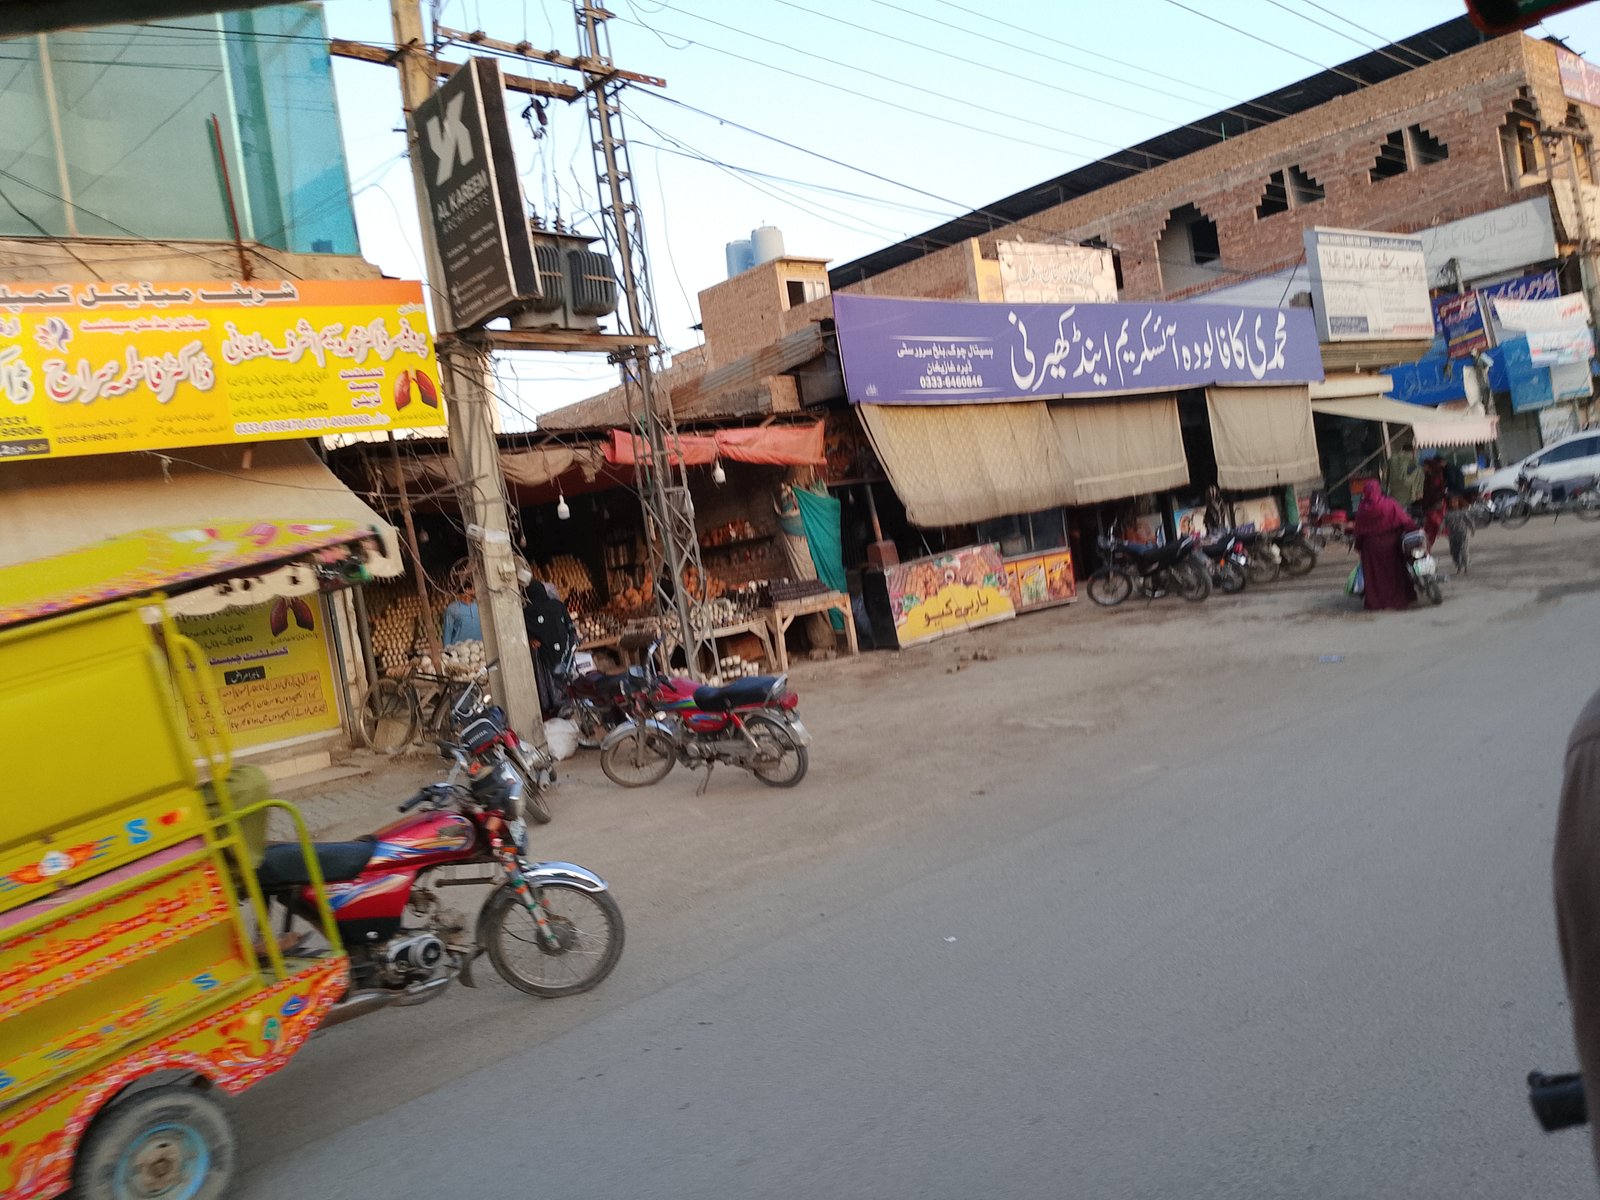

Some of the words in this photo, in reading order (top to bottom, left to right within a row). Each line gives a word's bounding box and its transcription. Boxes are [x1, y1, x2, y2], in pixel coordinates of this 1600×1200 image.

[79, 282, 194, 307] میڈیکل
[199, 281, 298, 305] شریف
[1072, 320, 1112, 387] اینڈ
[1244, 310, 1287, 380] محمدی
[157, 339, 216, 404] ڈاکٹر
[235, 635, 254, 645] DHQ
